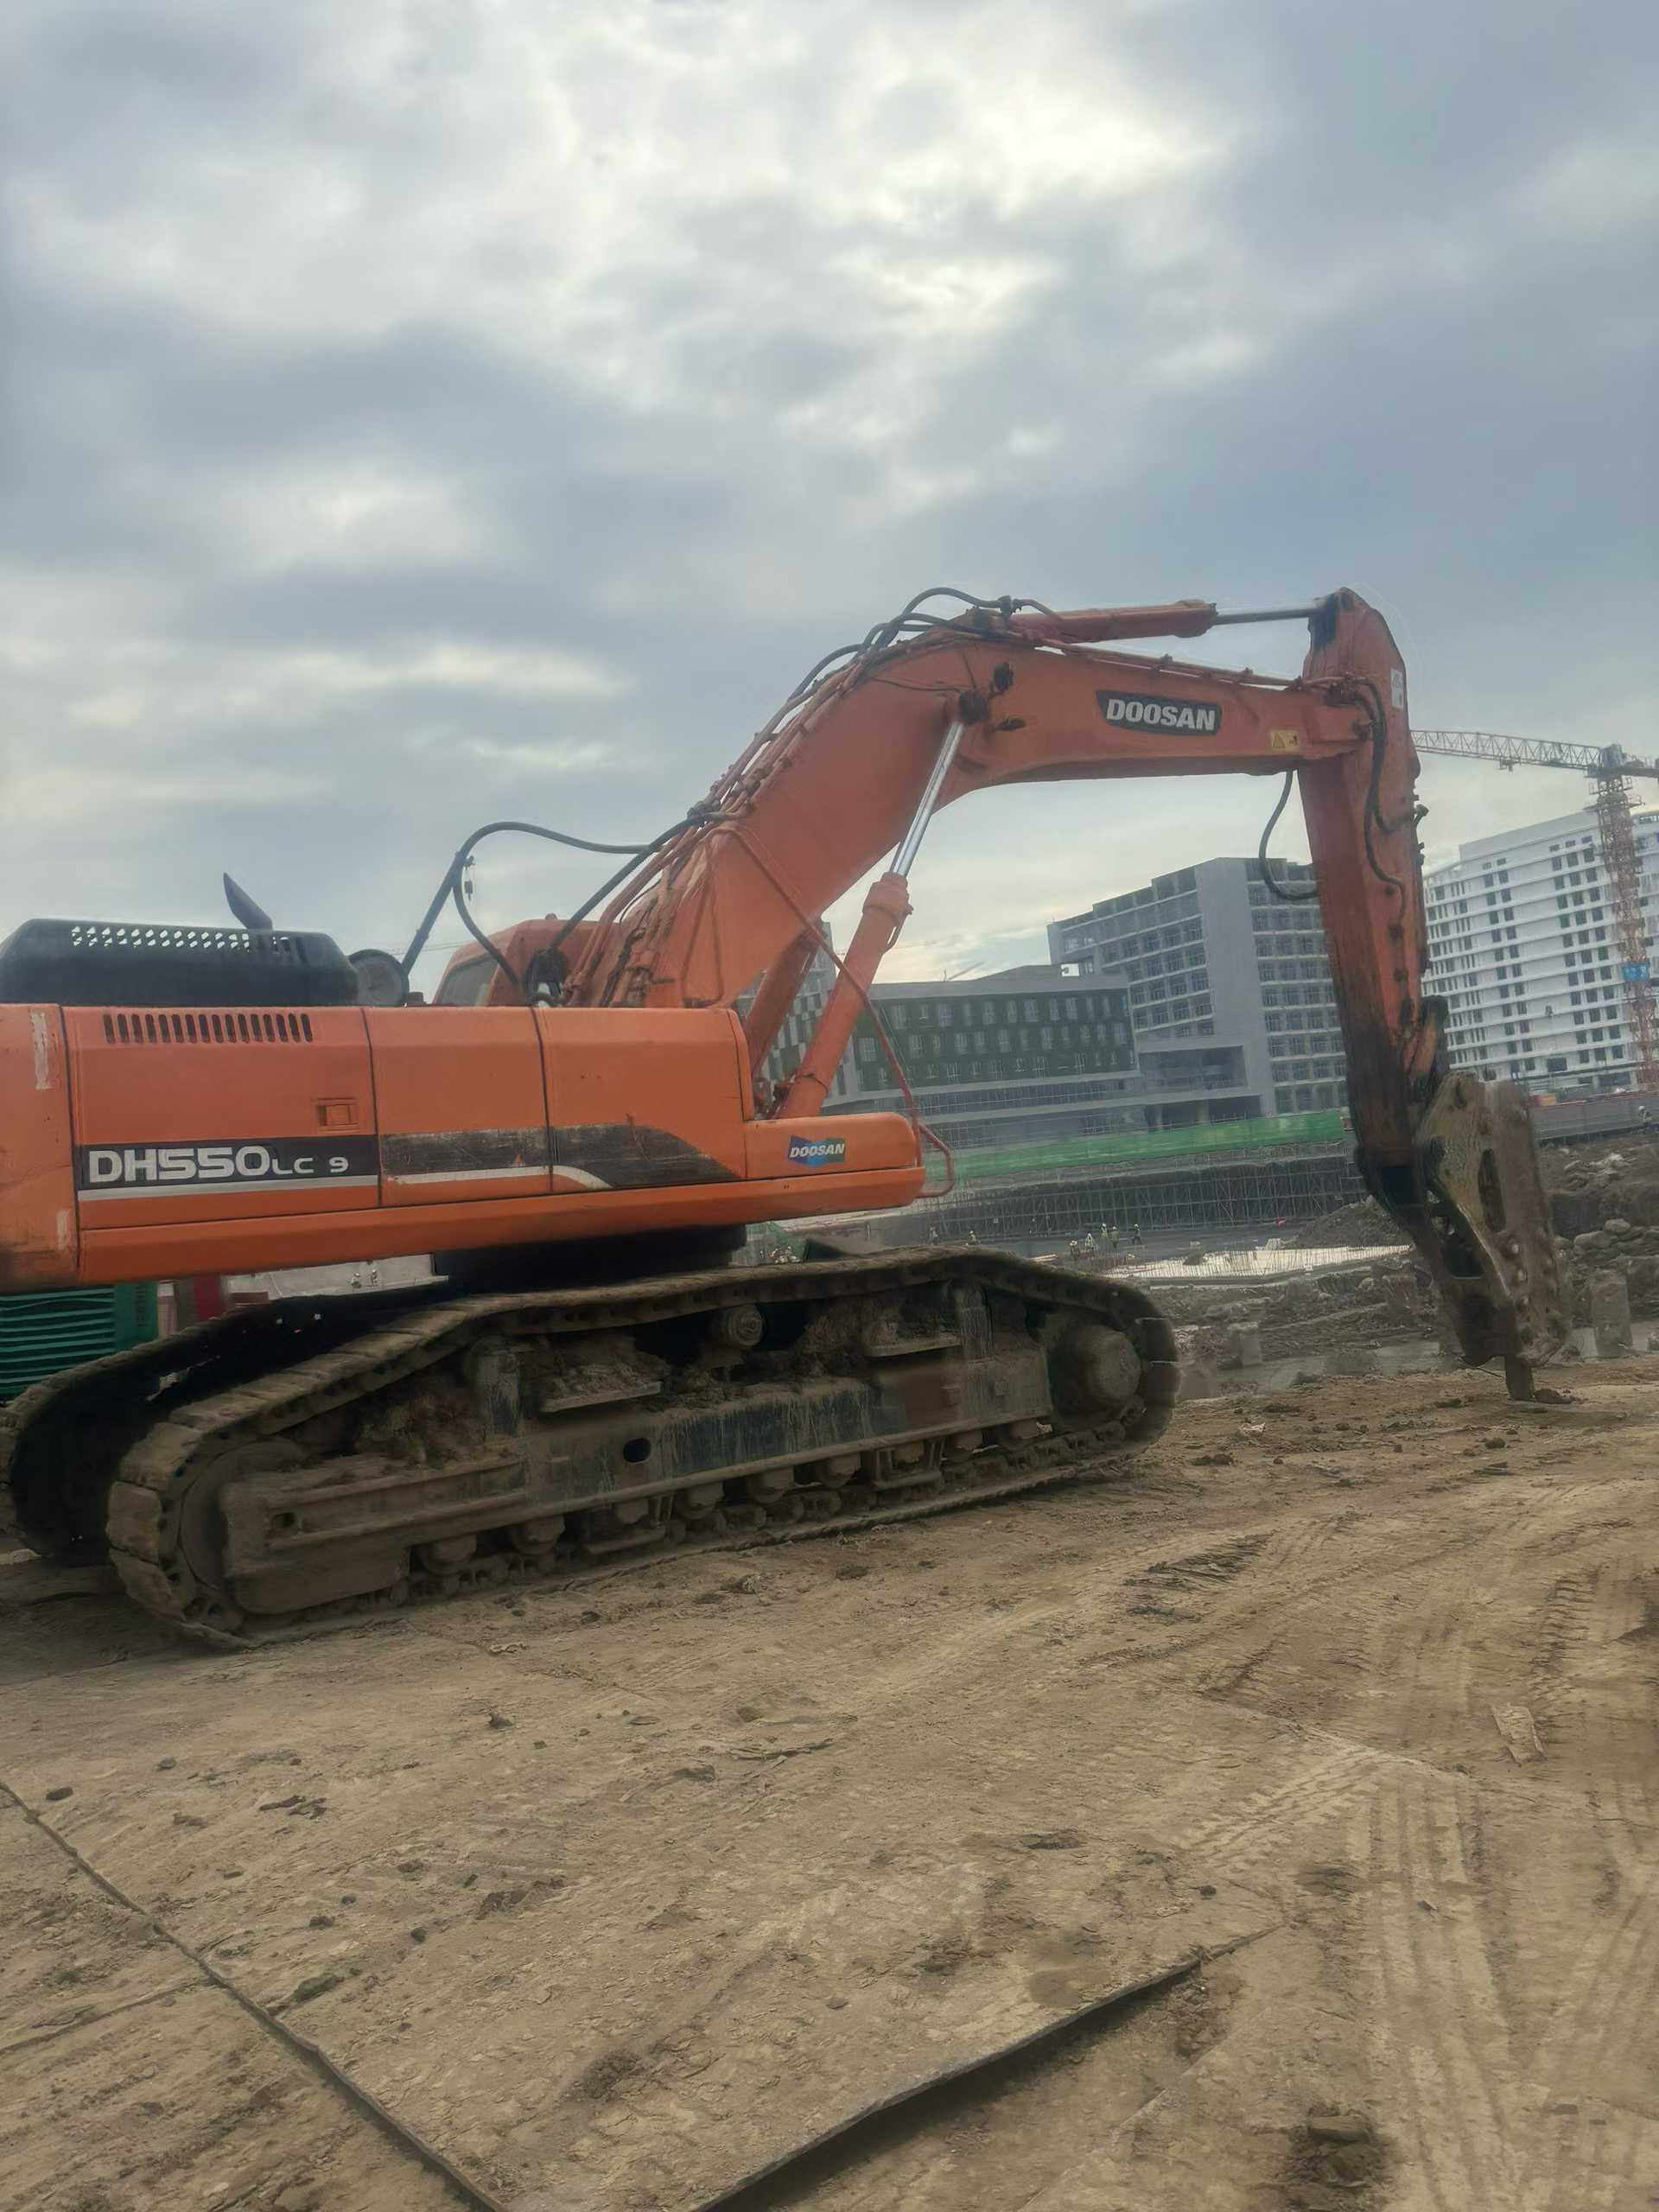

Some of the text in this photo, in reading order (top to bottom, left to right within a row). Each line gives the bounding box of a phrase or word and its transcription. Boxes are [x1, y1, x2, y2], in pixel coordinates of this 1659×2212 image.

[1106, 698, 1215, 731] DOOSAN
[789, 1143, 845, 1159] DOOSAN
[328, 1156, 349, 1173] 9
